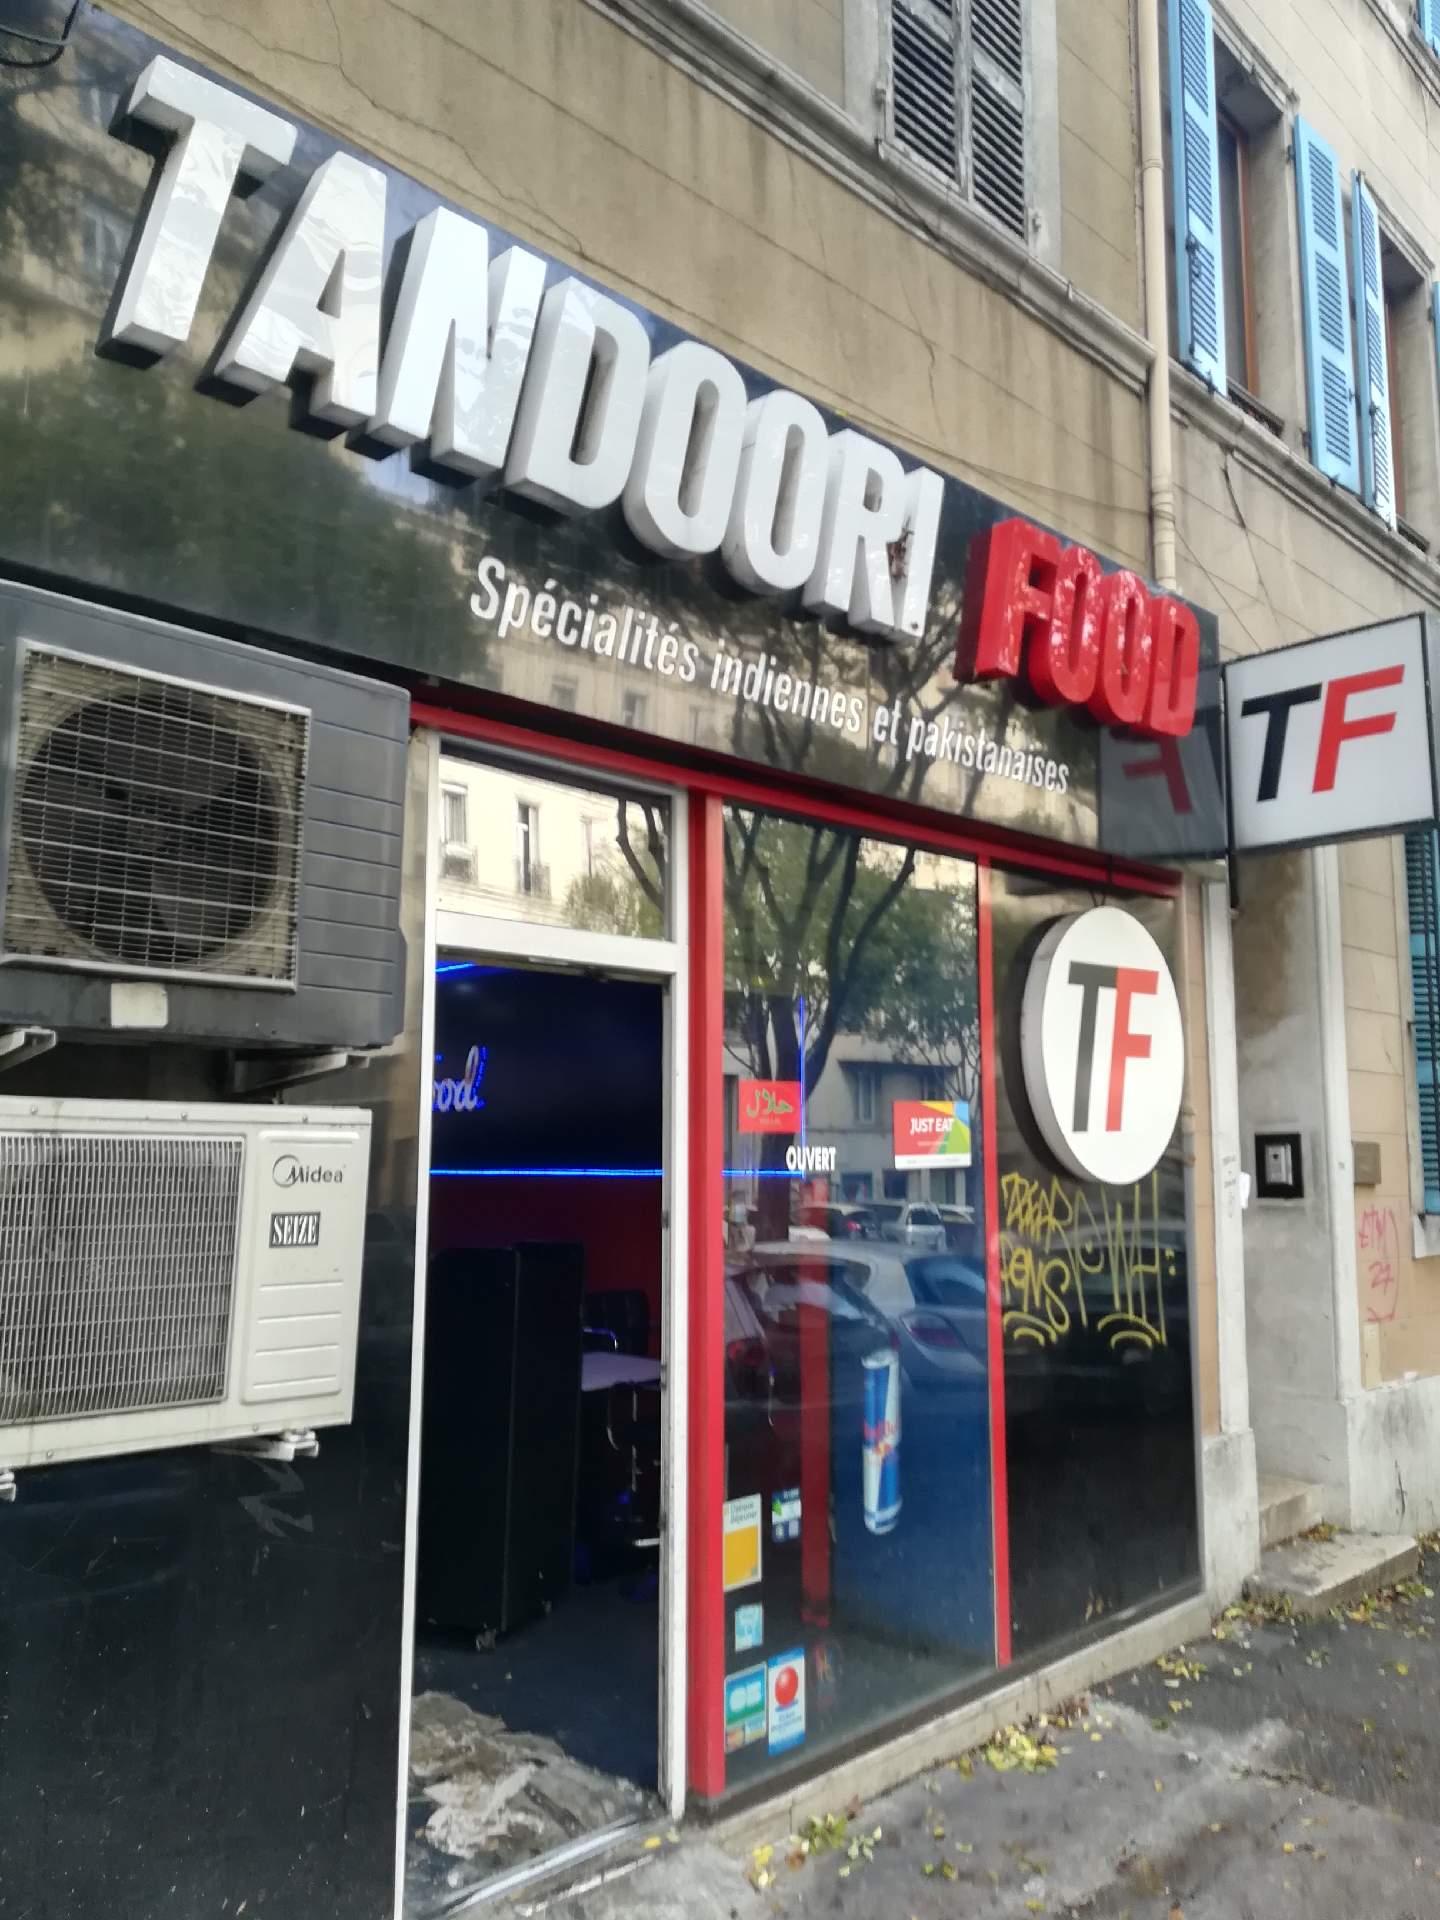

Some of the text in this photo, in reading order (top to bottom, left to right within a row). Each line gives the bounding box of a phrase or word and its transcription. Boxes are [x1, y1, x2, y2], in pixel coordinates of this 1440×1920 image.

[112, 54, 1199, 737] TANDOORI FOOD
[470, 555, 1069, 795] Spécialités indiennes et pakistanaises
[1241, 664, 1405, 803] TF
[1068, 961, 1159, 1133] TF
[785, 1145, 836, 1171] OUVERT
[910, 1117, 955, 1136] JUST EAT
[271, 1213, 320, 1245] SEIZE
